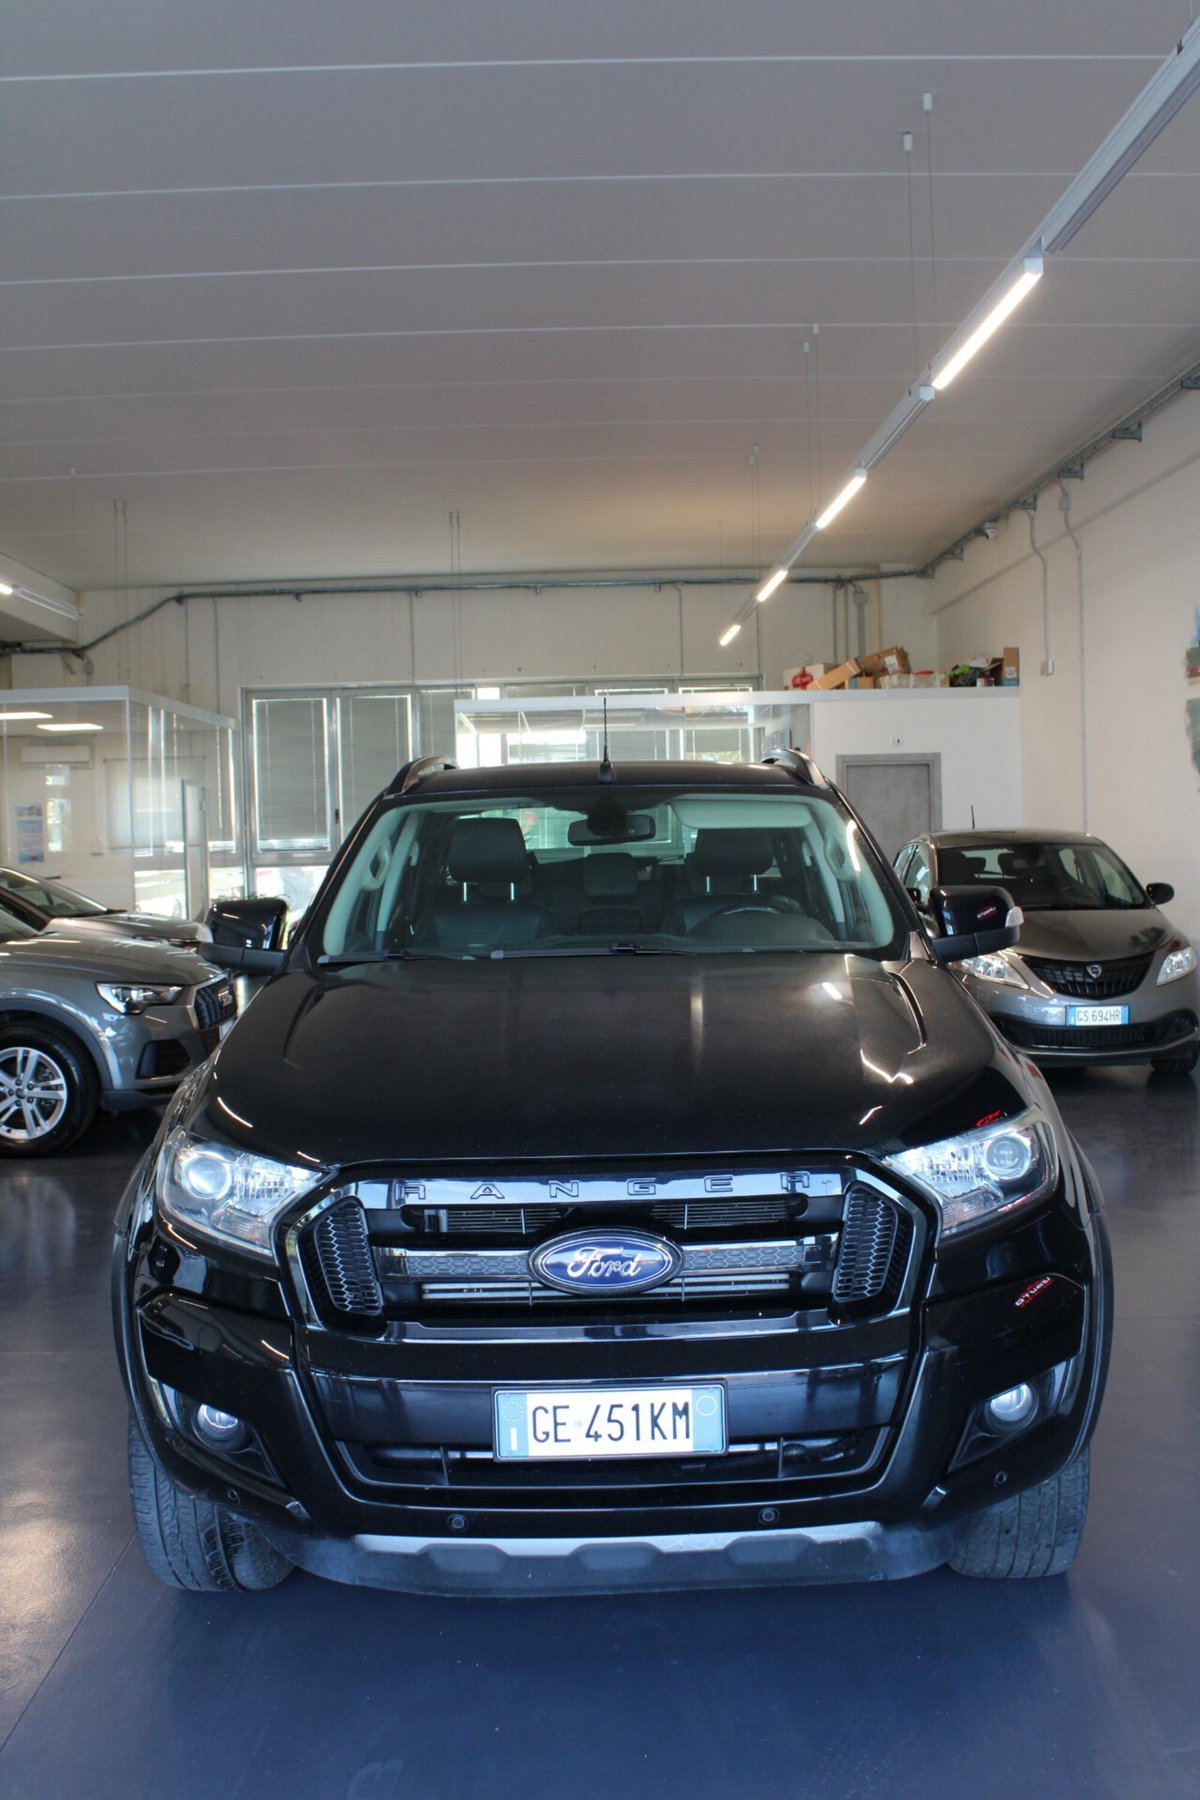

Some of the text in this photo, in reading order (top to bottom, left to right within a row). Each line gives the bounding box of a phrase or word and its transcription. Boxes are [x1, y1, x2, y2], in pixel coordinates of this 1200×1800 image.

[1091, 1009, 1121, 1022] 694HR
[397, 1172, 809, 1200] RANGER
[567, 1246, 642, 1277] Ford
[532, 1405, 571, 1443] GE
[585, 1401, 691, 1442] 451KM
